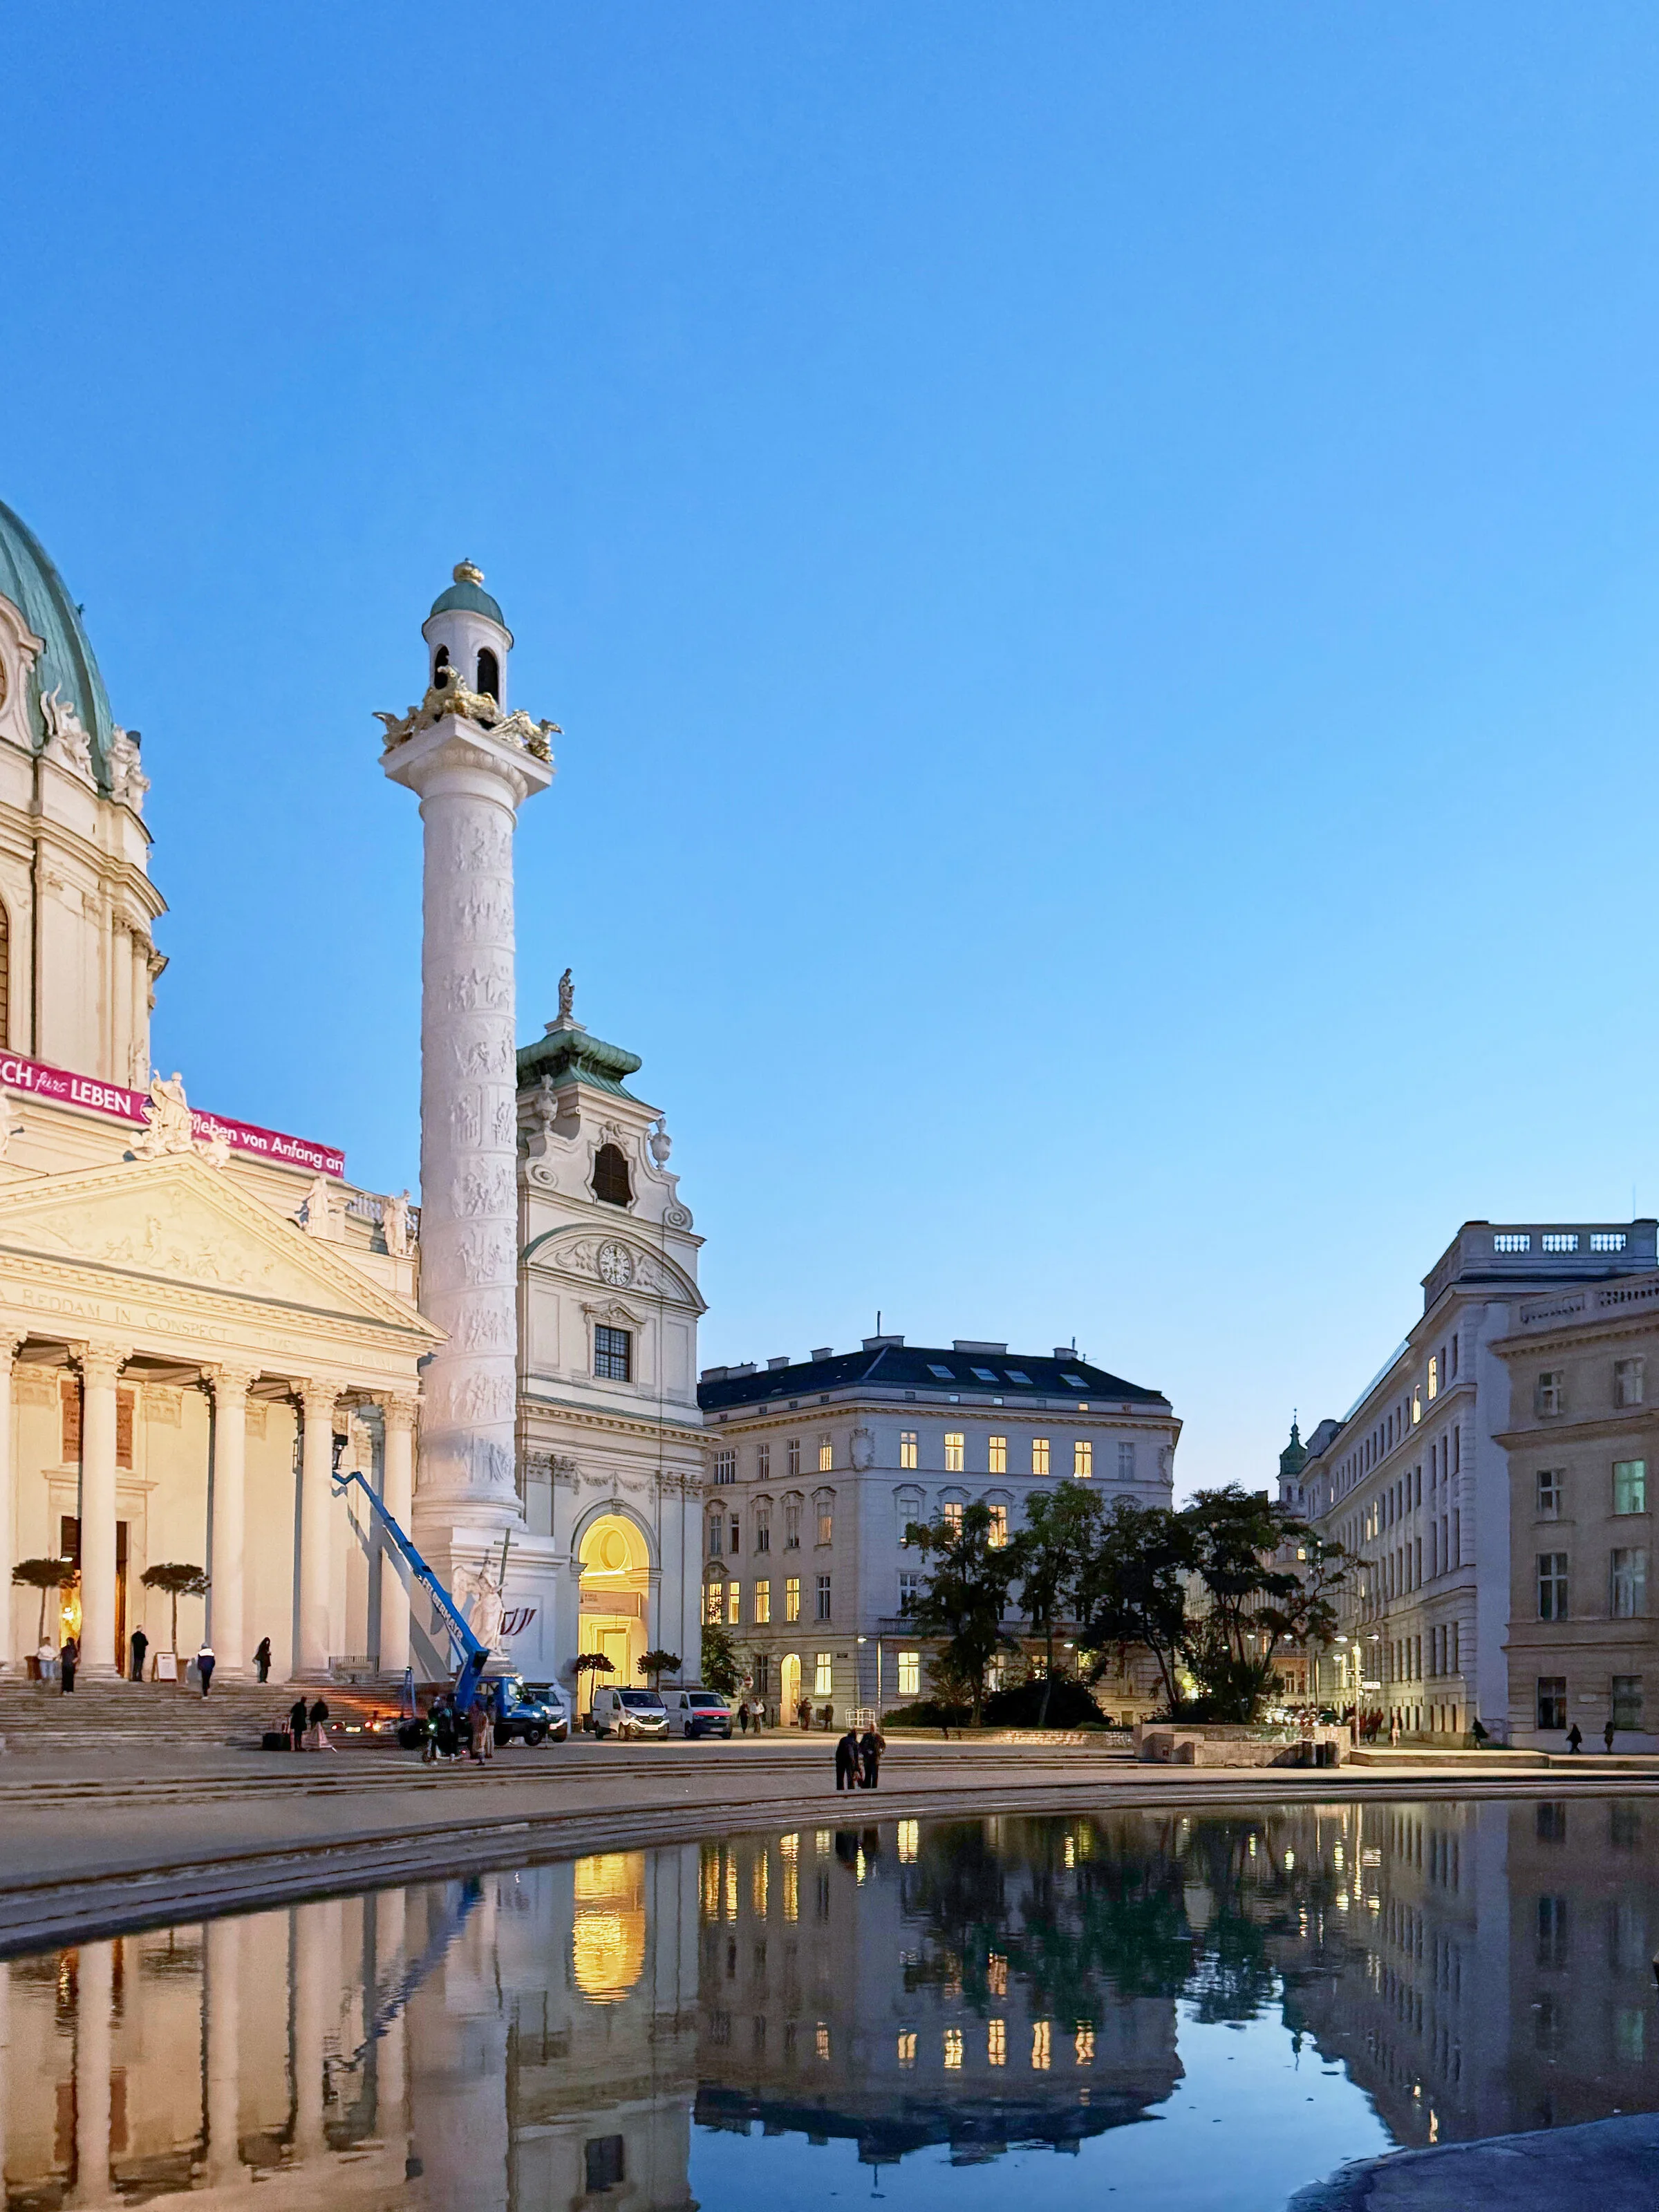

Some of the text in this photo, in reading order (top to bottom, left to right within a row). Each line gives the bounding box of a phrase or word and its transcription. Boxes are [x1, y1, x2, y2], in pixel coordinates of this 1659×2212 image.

[0, 1060, 33, 1087] CH
[71, 1078, 131, 1115] LEBEN
[241, 1132, 268, 1150] von
[271, 1136, 324, 1169] Anfang
[326, 1156, 344, 1172] an
